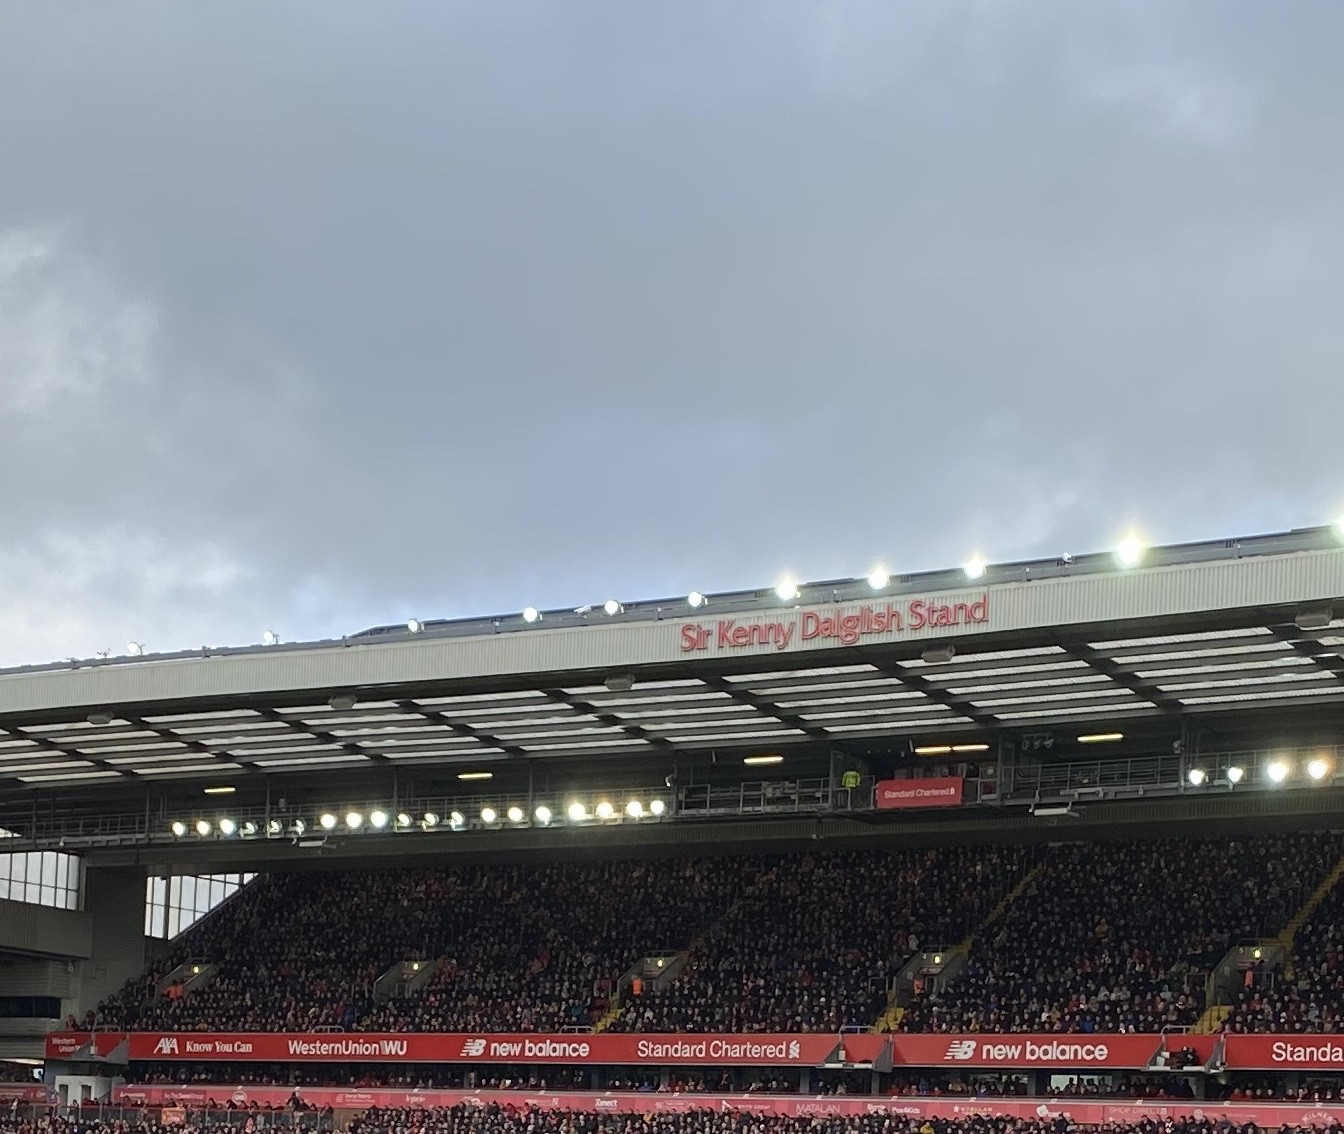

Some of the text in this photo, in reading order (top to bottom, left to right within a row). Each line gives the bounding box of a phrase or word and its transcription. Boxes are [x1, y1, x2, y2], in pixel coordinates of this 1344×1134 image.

[680, 592, 990, 651] Sir Kenny Dalglish Stand
[884, 787, 949, 798] Standard Chartered
[153, 1037, 253, 1055] AXA Know You Can
[490, 1042, 522, 1056] new
[524, 1039, 590, 1057] balance
[637, 1040, 786, 1058] Standard Chartered
[982, 1044, 1023, 1060] new
[1025, 1040, 1108, 1060] balance
